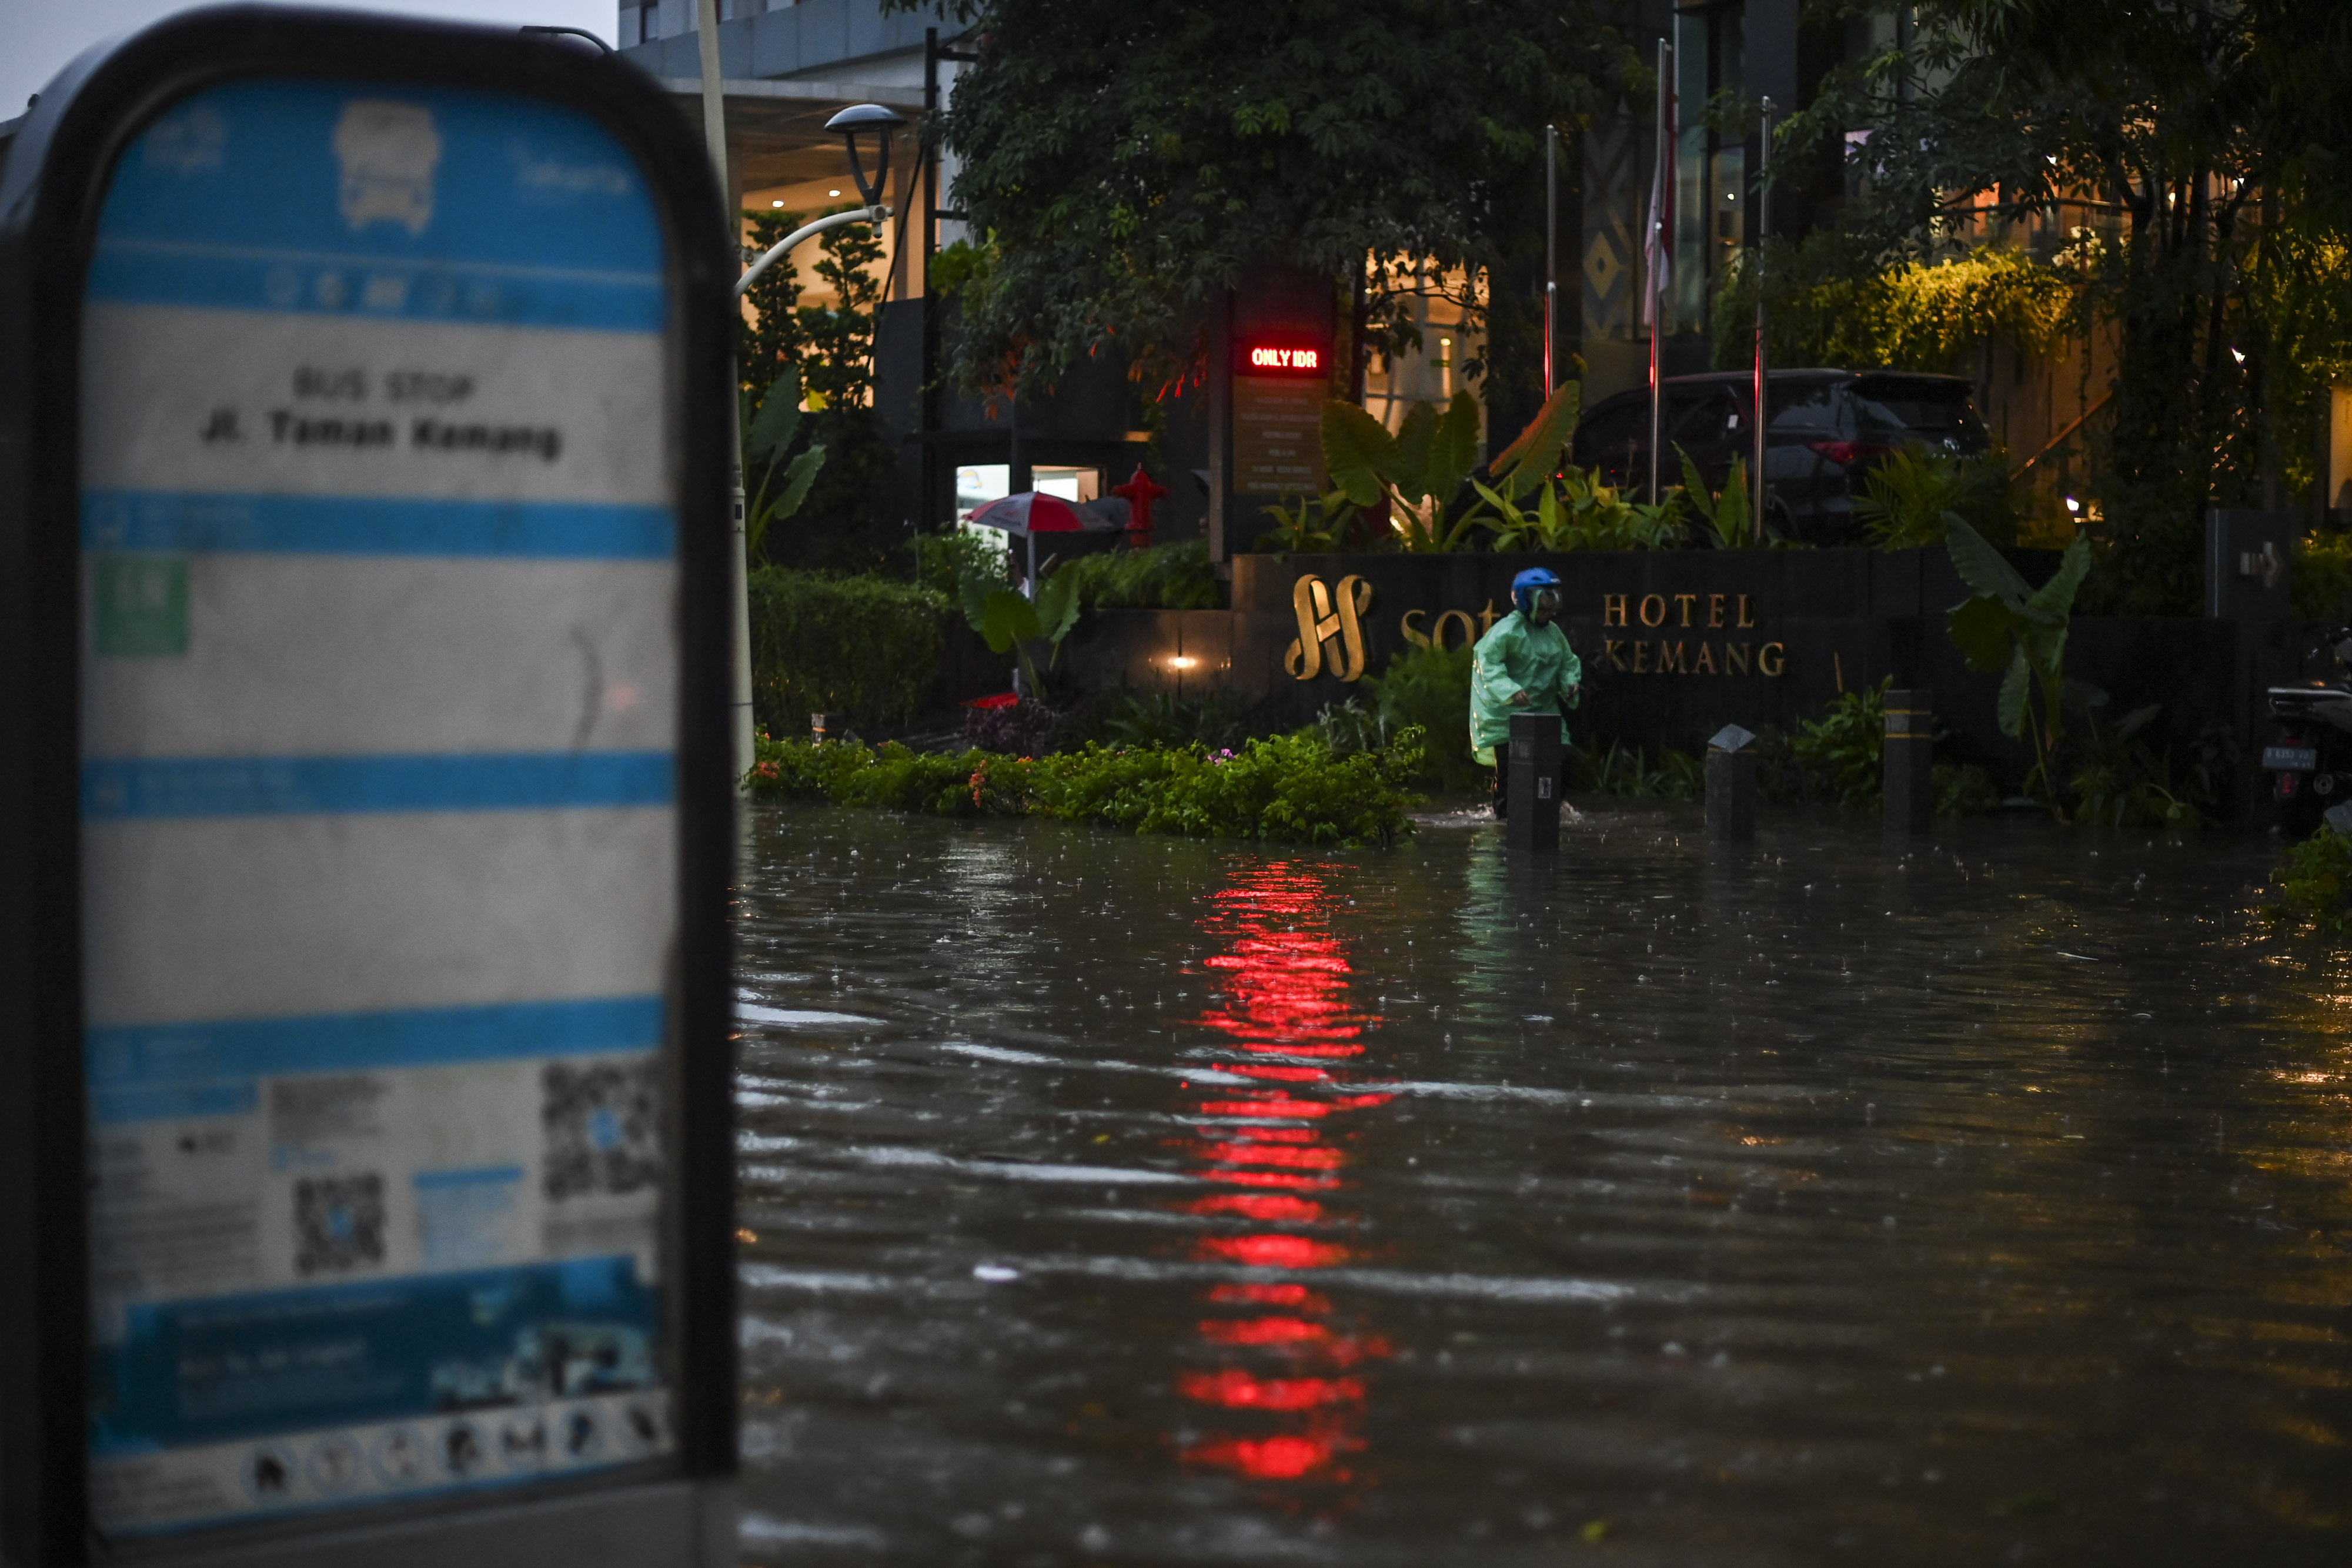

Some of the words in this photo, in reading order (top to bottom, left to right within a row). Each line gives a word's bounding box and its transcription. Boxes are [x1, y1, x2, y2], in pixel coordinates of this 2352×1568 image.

[1252, 348, 1291, 366] ONLY
[1292, 350, 1317, 368] IDR
[293, 367, 368, 401] BUS
[383, 370, 477, 407] STOP
[201, 407, 245, 445] Jl.
[267, 409, 395, 451] Taman
[410, 415, 563, 463] Kemang
[1603, 594, 1755, 628] HOTEL
[1605, 639, 1787, 677] KEMANG
